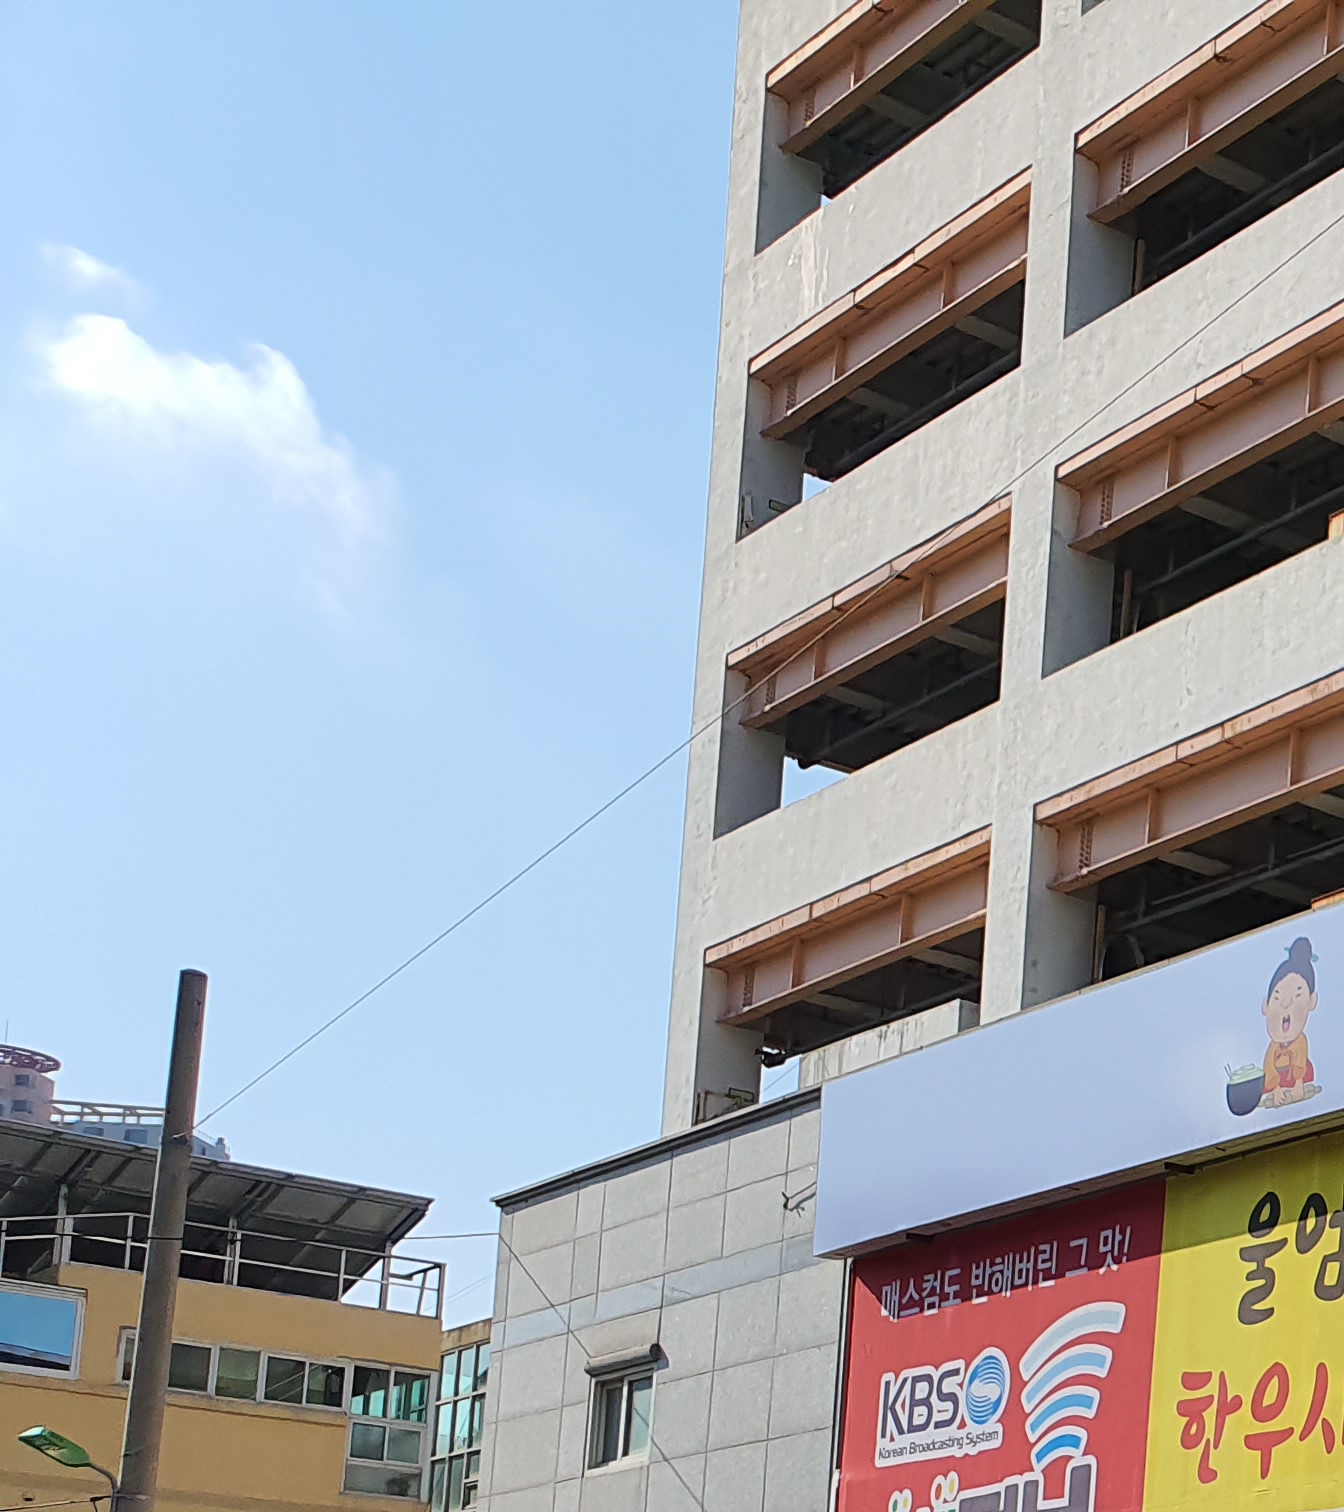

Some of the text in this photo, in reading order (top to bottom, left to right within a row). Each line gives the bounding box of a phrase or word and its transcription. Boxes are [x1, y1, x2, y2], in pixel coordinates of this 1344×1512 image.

[880, 1223, 1132, 1323] 매스컴도 반해버린 그 맛!
[880, 1366, 962, 1440] KBS
[878, 1429, 1000, 1460] Korean Broadcasting System
